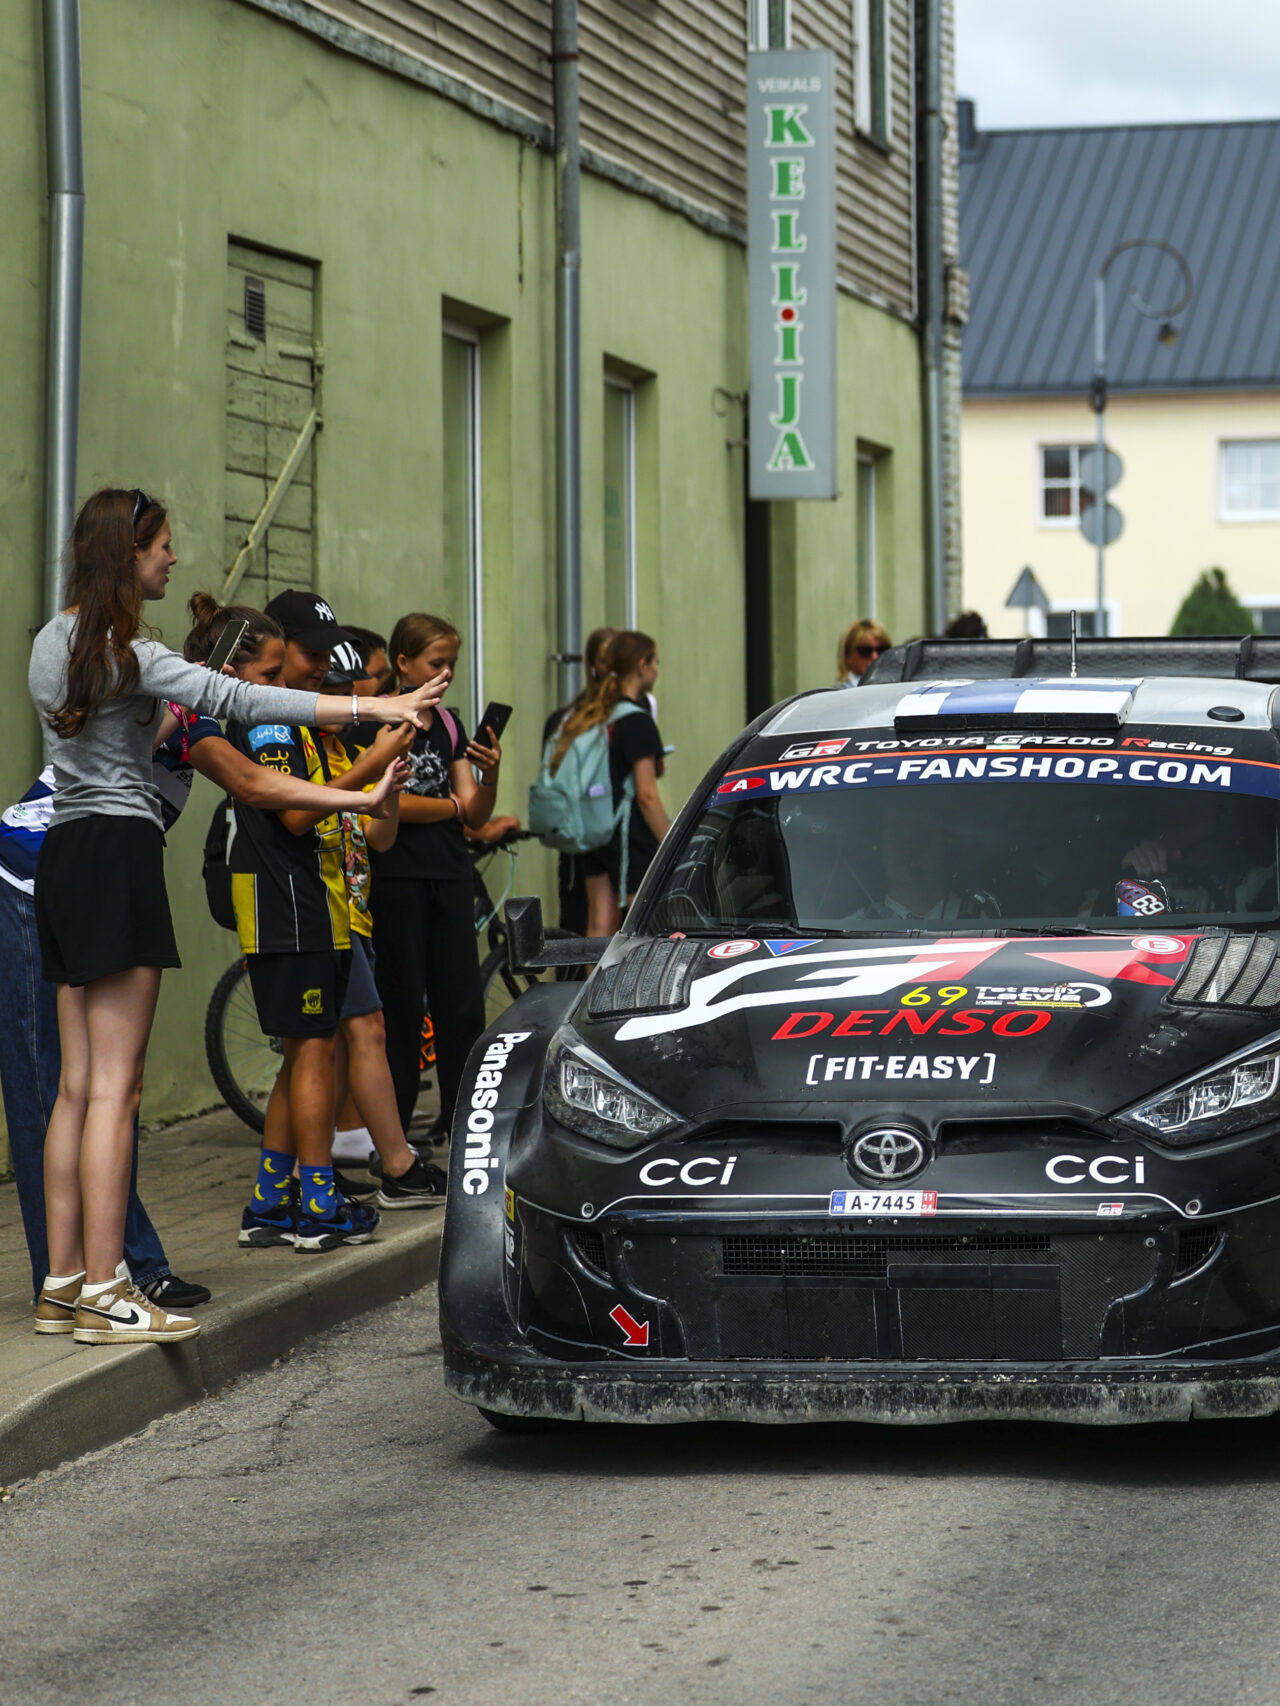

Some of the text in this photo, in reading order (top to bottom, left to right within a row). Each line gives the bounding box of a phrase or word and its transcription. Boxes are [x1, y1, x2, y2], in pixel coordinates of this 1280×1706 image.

[758, 76, 821, 94] VEIKALS
[782, 742, 847, 759] GR
[855, 734, 1235, 756] TOYOTA GAZOO Racing
[769, 756, 1232, 791] WRC-FANSHOP.COM
[900, 985, 969, 1007] 69
[976, 990, 1081, 1002] Latvia
[1021, 984, 1083, 994] Rally
[771, 1009, 1053, 1041] DENSO
[462, 1032, 531, 1197] Panasonic
[850, 1195, 916, 1211] A-7445
